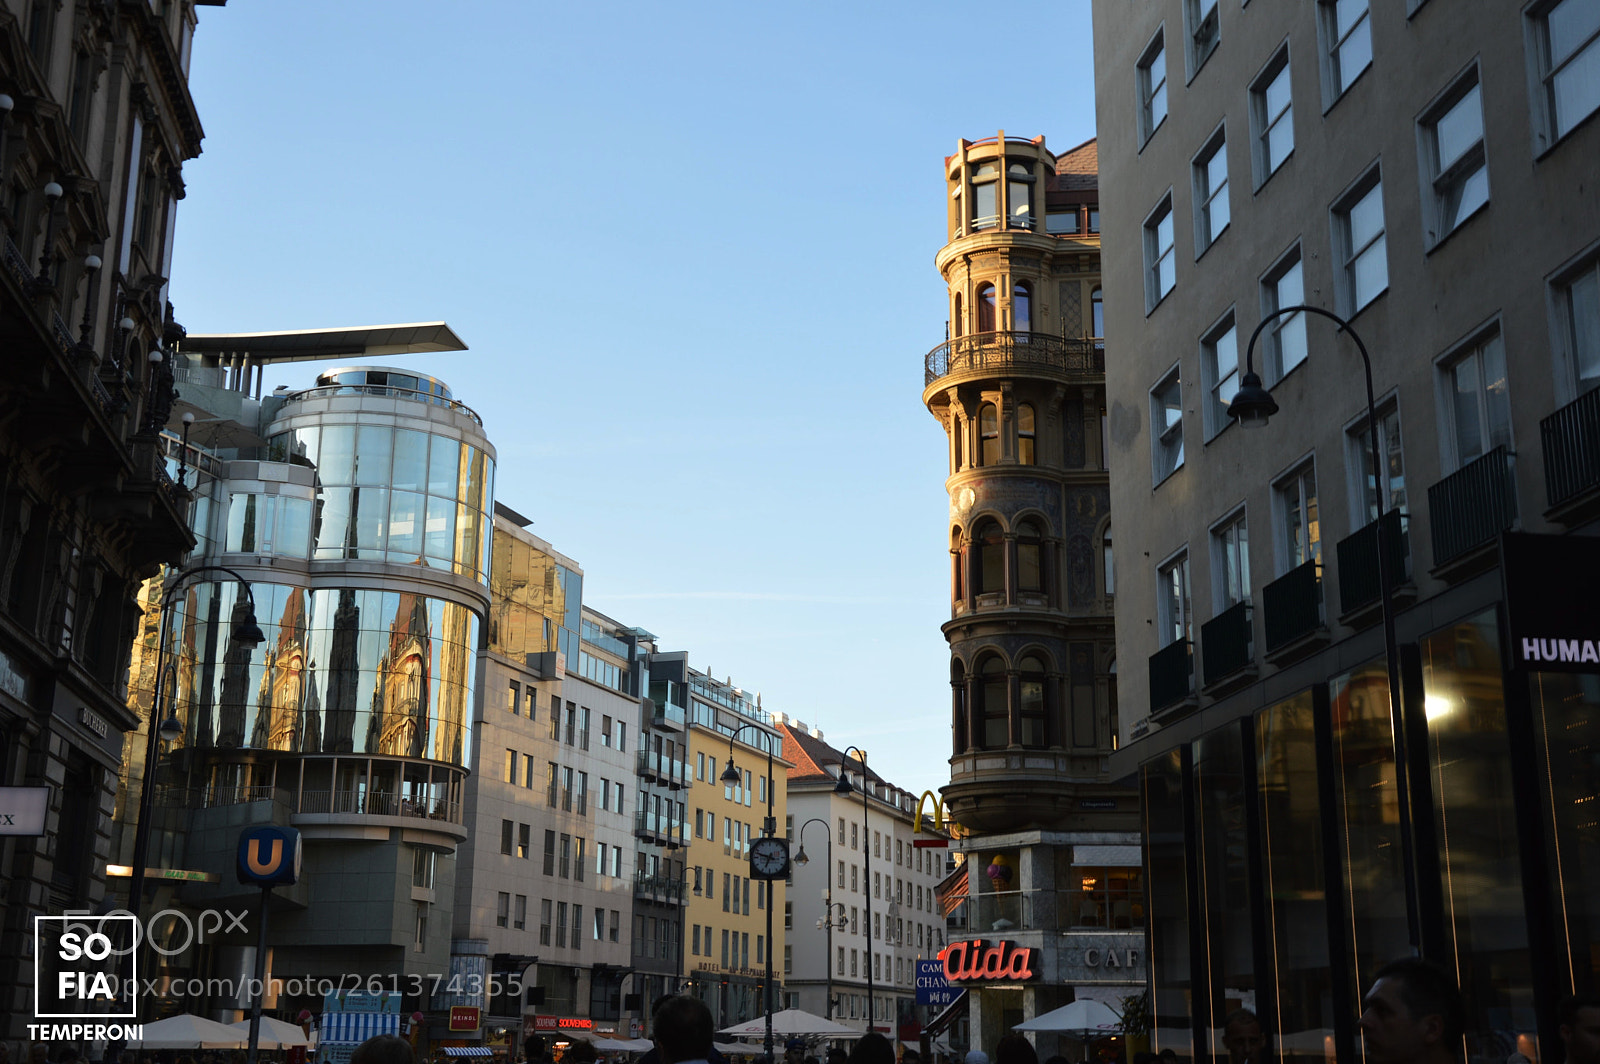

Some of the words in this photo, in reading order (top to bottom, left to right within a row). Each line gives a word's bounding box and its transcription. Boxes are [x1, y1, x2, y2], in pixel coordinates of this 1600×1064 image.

[1522, 637, 1600, 663] HUMA
[0, 814, 15, 825] X
[247, 839, 284, 876] U
[698, 962, 719, 972] HOTEL
[921, 963, 944, 973] CAM
[917, 977, 951, 988] CHAN
[558, 1018, 592, 1028] SOUVENIRS
